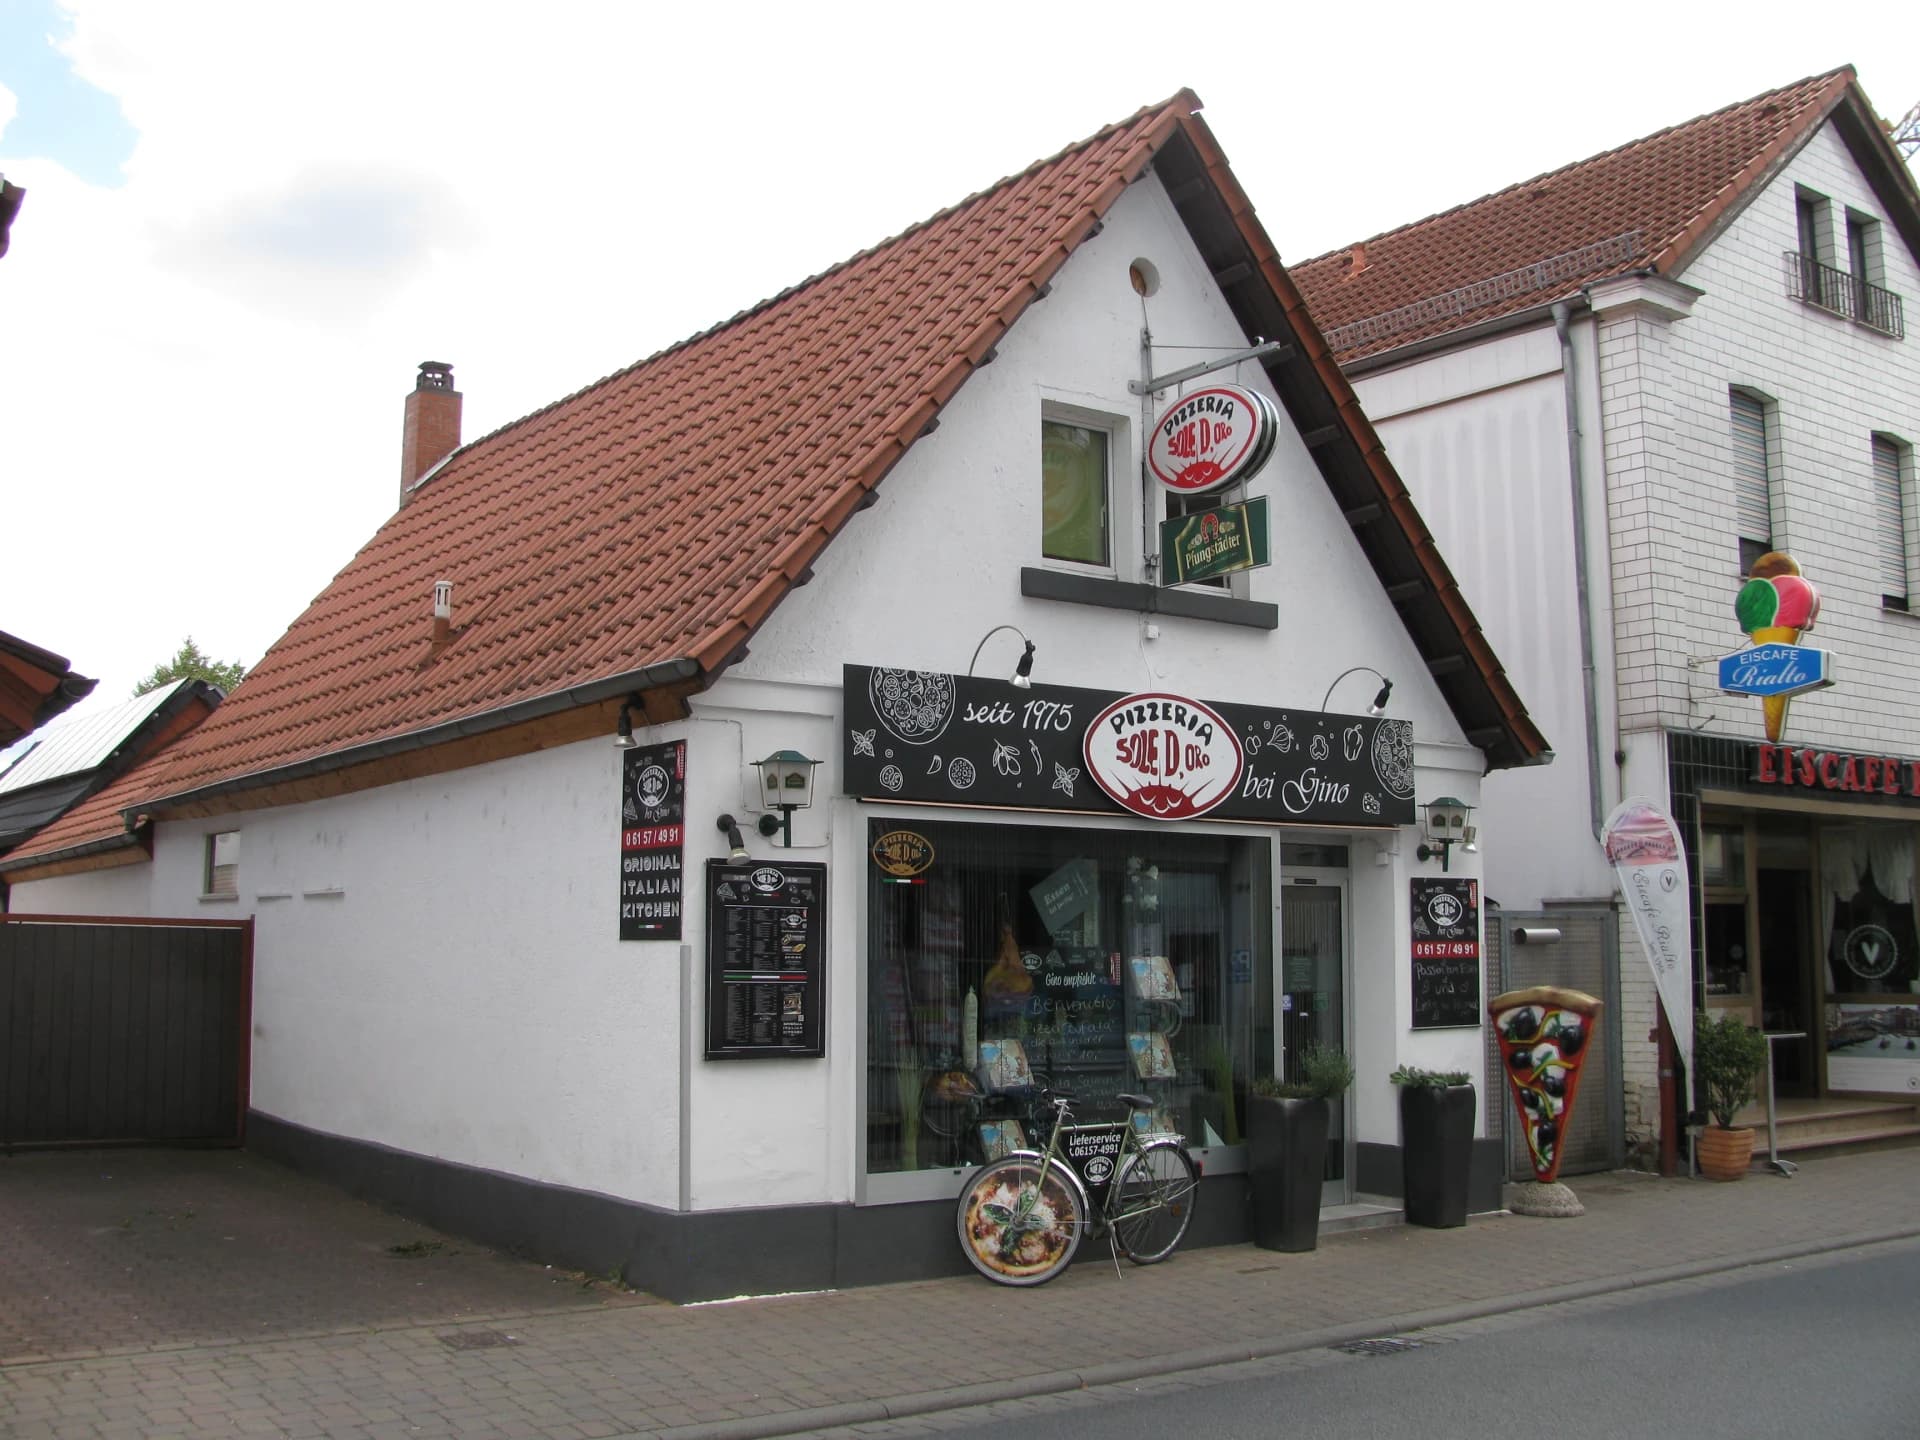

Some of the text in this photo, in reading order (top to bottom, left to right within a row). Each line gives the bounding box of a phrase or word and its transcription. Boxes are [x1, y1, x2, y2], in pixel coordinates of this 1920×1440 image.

[1164, 396, 1234, 437] PIZZERIA
[1167, 421, 1196, 459] SOLE
[1186, 534, 1240, 569] Pfungstädter
[1740, 649, 1800, 665] EISCAFE
[1727, 660, 1808, 688] Rialto
[963, 700, 1074, 731] seit 1975
[1110, 702, 1213, 746] PIZZERIA
[1116, 729, 1159, 776] SOLE
[1185, 744, 1210, 771] ORO
[1759, 743, 1899, 795] EISCAFE
[1242, 764, 1350, 814] bei Gino
[643, 830, 652, 845] 57
[658, 829, 668, 843] 49
[669, 828, 679, 841] 91
[624, 854, 680, 872] ORIGINAL
[623, 878, 680, 896] ITALIAN
[623, 901, 680, 918] KITCHEN
[1437, 944, 1446, 954] 57
[1453, 944, 1462, 954] 49
[1464, 943, 1474, 954] 91
[1045, 972, 1062, 987] Gino
[1070, 1132, 1121, 1146] Lieferservice
[1075, 1143, 1119, 1156] 06157-4991
